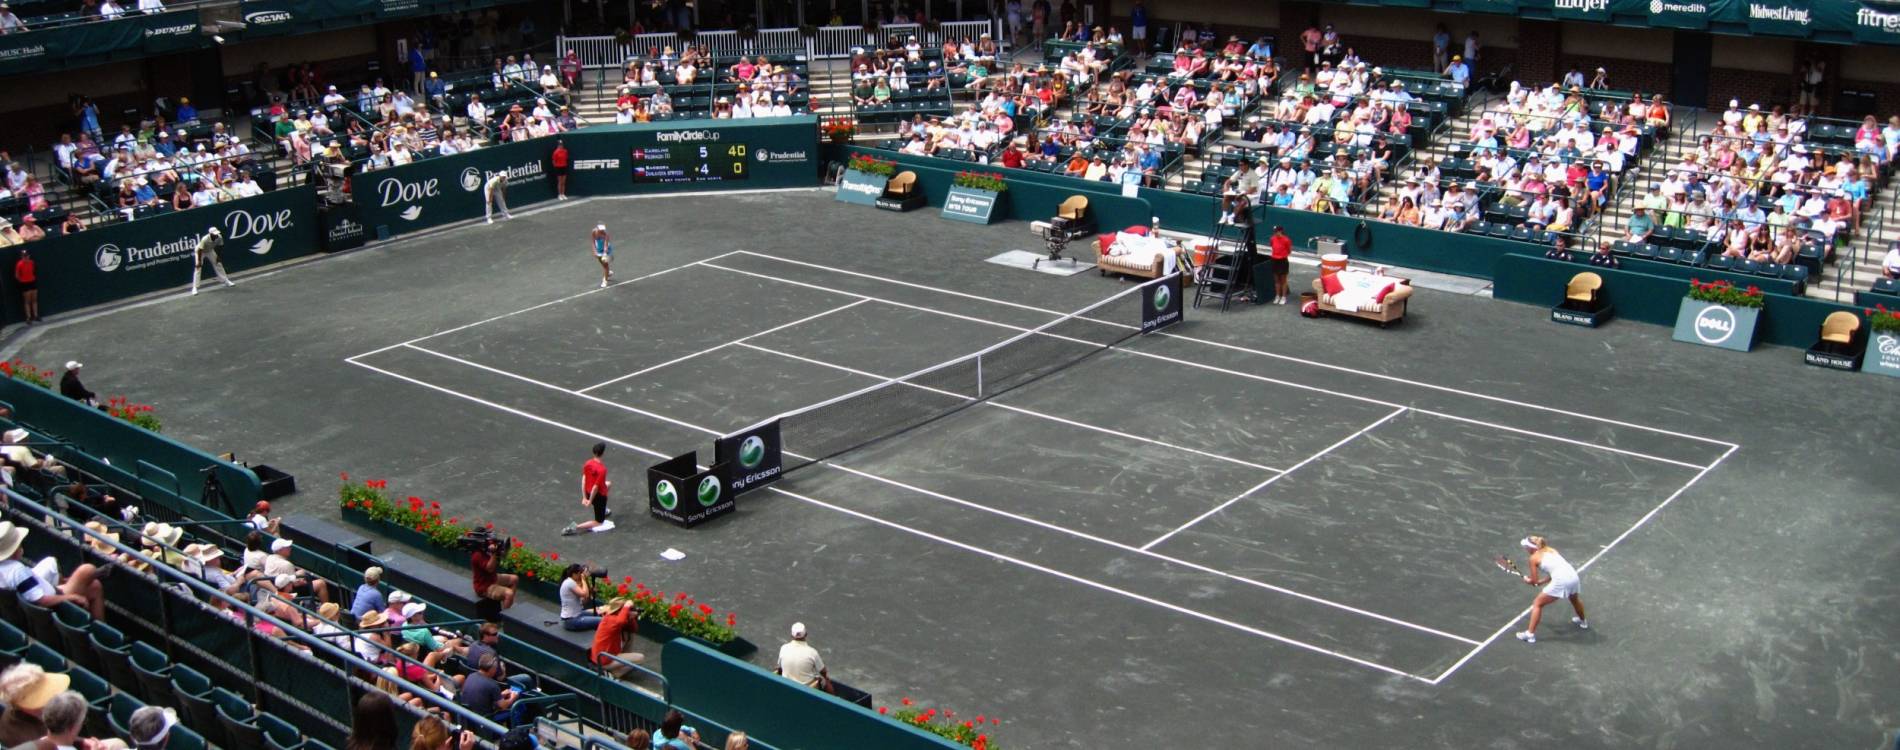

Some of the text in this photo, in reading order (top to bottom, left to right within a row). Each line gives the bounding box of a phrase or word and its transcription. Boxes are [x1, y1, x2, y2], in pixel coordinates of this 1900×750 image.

[1664, 3, 1706, 13] meredith
[1749, 3, 1782, 20] Midwest
[1856, 8, 1900, 28] fitne
[154, 24, 197, 35] DUNLOP
[700, 144, 746, 158] 5 40
[770, 150, 806, 160] Prudential
[573, 158, 620, 170] ESPN2
[700, 162, 742, 175] 4 0
[377, 177, 439, 208] Dove
[224, 208, 292, 240] Dove
[126, 233, 201, 263] Prudential
[1699, 317, 1730, 331] DELL
[745, 466, 781, 484] Ericsson
[688, 500, 734, 523] Sony Ericsson
